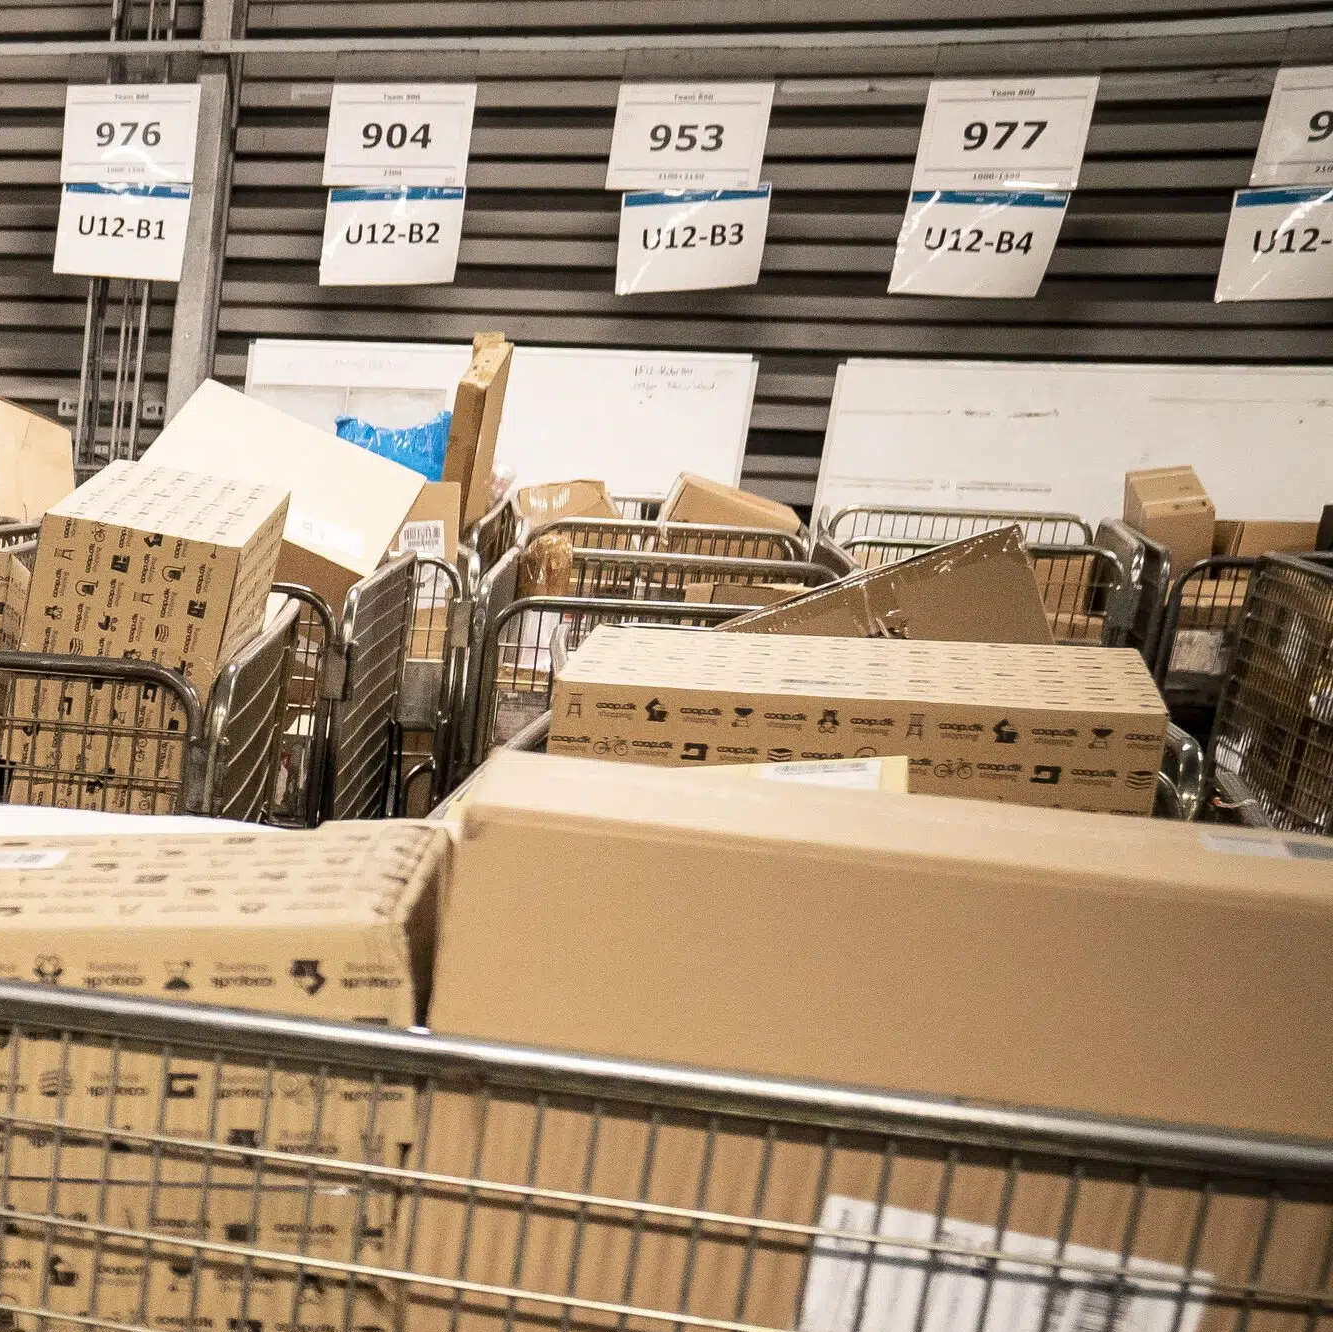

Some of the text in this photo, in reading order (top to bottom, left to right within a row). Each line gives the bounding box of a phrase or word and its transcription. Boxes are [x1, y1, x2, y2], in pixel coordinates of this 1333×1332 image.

[97, 122, 160, 146] 976
[363, 123, 431, 148] 904
[650, 125, 724, 151] 953
[964, 121, 1047, 150] 977
[79, 216, 164, 239] U12-B1
[346, 223, 439, 244] U12-B2
[643, 223, 743, 249] U12-B3
[925, 228, 1033, 254] U12-B4
[86, 544, 96, 573] coop.dk
[141, 553, 151, 583] coop.dk
[53, 568, 63, 597] coop.dk
[196, 564, 206, 593] coop.dk
[107, 579, 117, 608] coop.dk
[161, 588, 171, 618] coop.dk
[75, 603, 84, 632] coop.dk
[129, 613, 139, 642] coop.dk
[184, 624, 194, 653] coop.dk
[596, 702, 637, 711] coop.dk
[680, 707, 722, 716] coop.dk
[764, 712, 807, 722] coop.dk
[850, 717, 895, 727] coop.dk
[939, 721, 983, 732] coop.dk
[1032, 727, 1078, 738] coop.dk
[551, 735, 591, 744] coop.dk
[632, 740, 673, 750] coop.dk
[717, 745, 758, 756] coop.dk
[977, 762, 1022, 774] coop.dk
[1071, 768, 1118, 779] coop.dk
